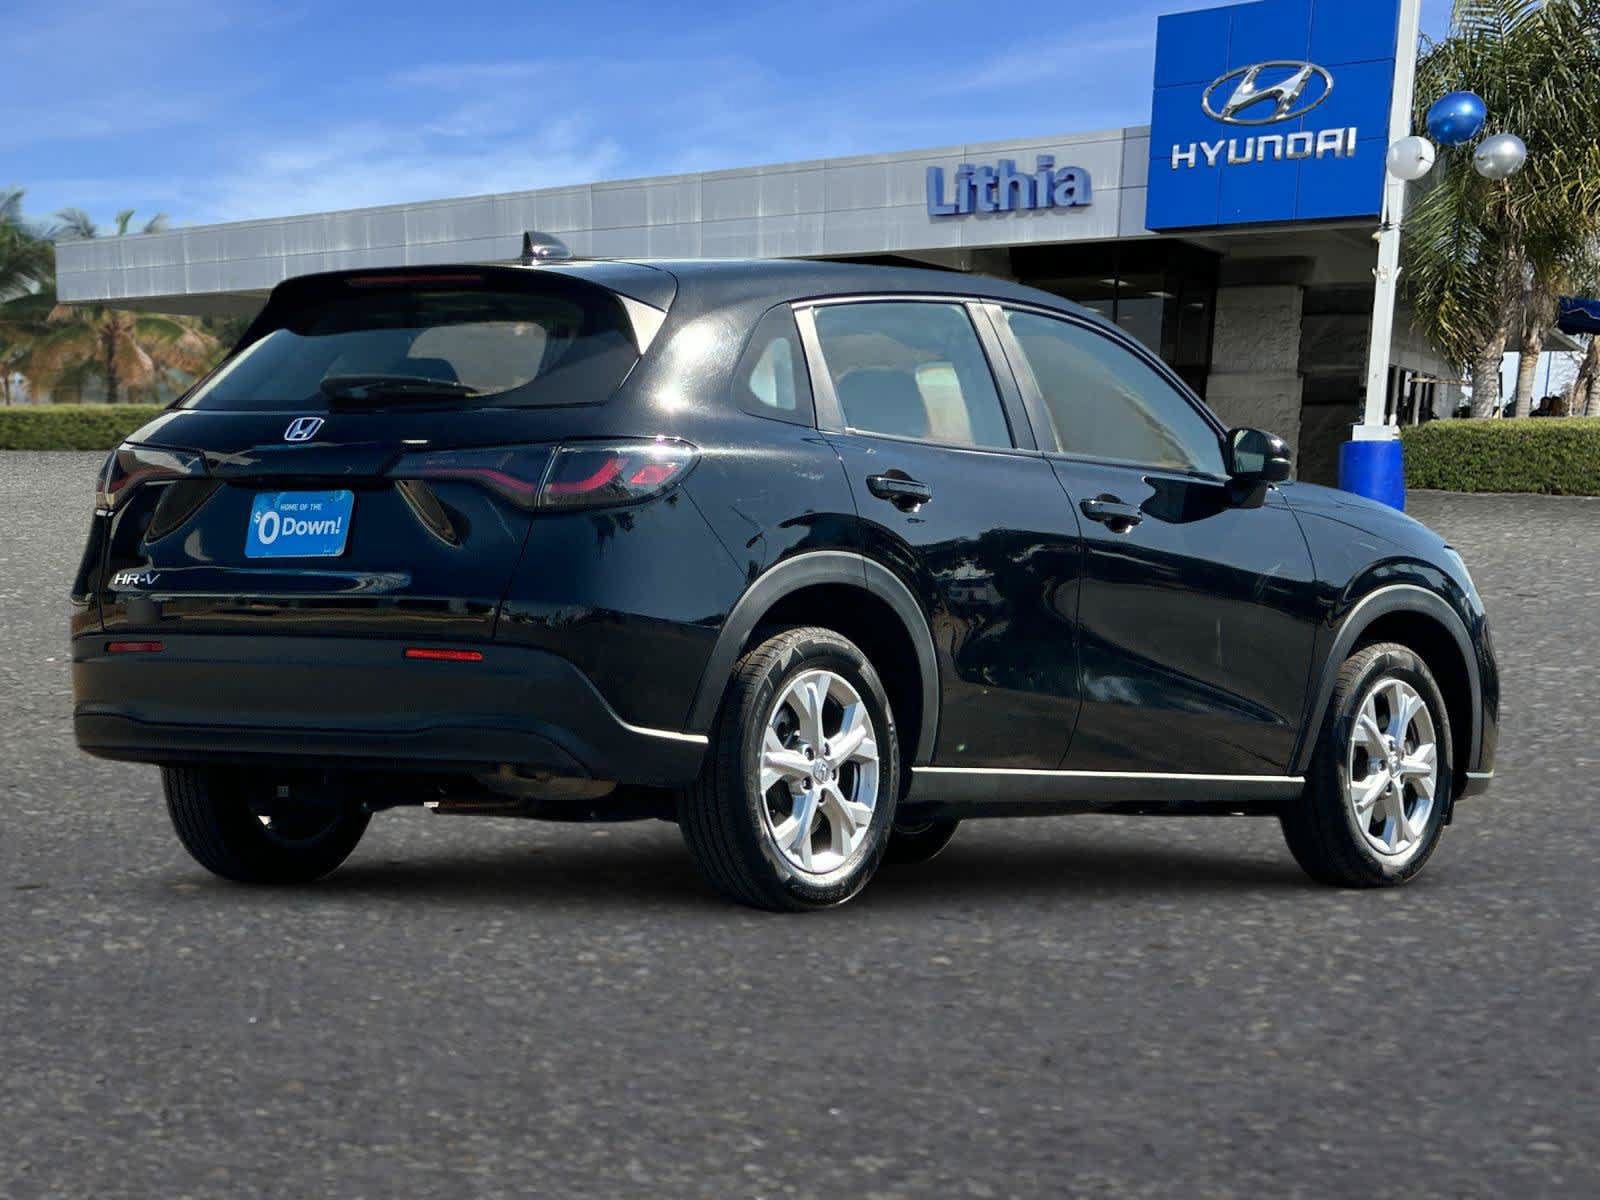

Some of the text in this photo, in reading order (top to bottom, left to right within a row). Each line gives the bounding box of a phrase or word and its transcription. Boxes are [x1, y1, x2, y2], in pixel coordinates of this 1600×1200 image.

[1171, 127, 1358, 169] HYUNDAI
[926, 154, 1093, 217] Lithia
[280, 503, 323, 512] HOME OF THE
[281, 516, 342, 536] Down!
[113, 573, 161, 585] HR-V
